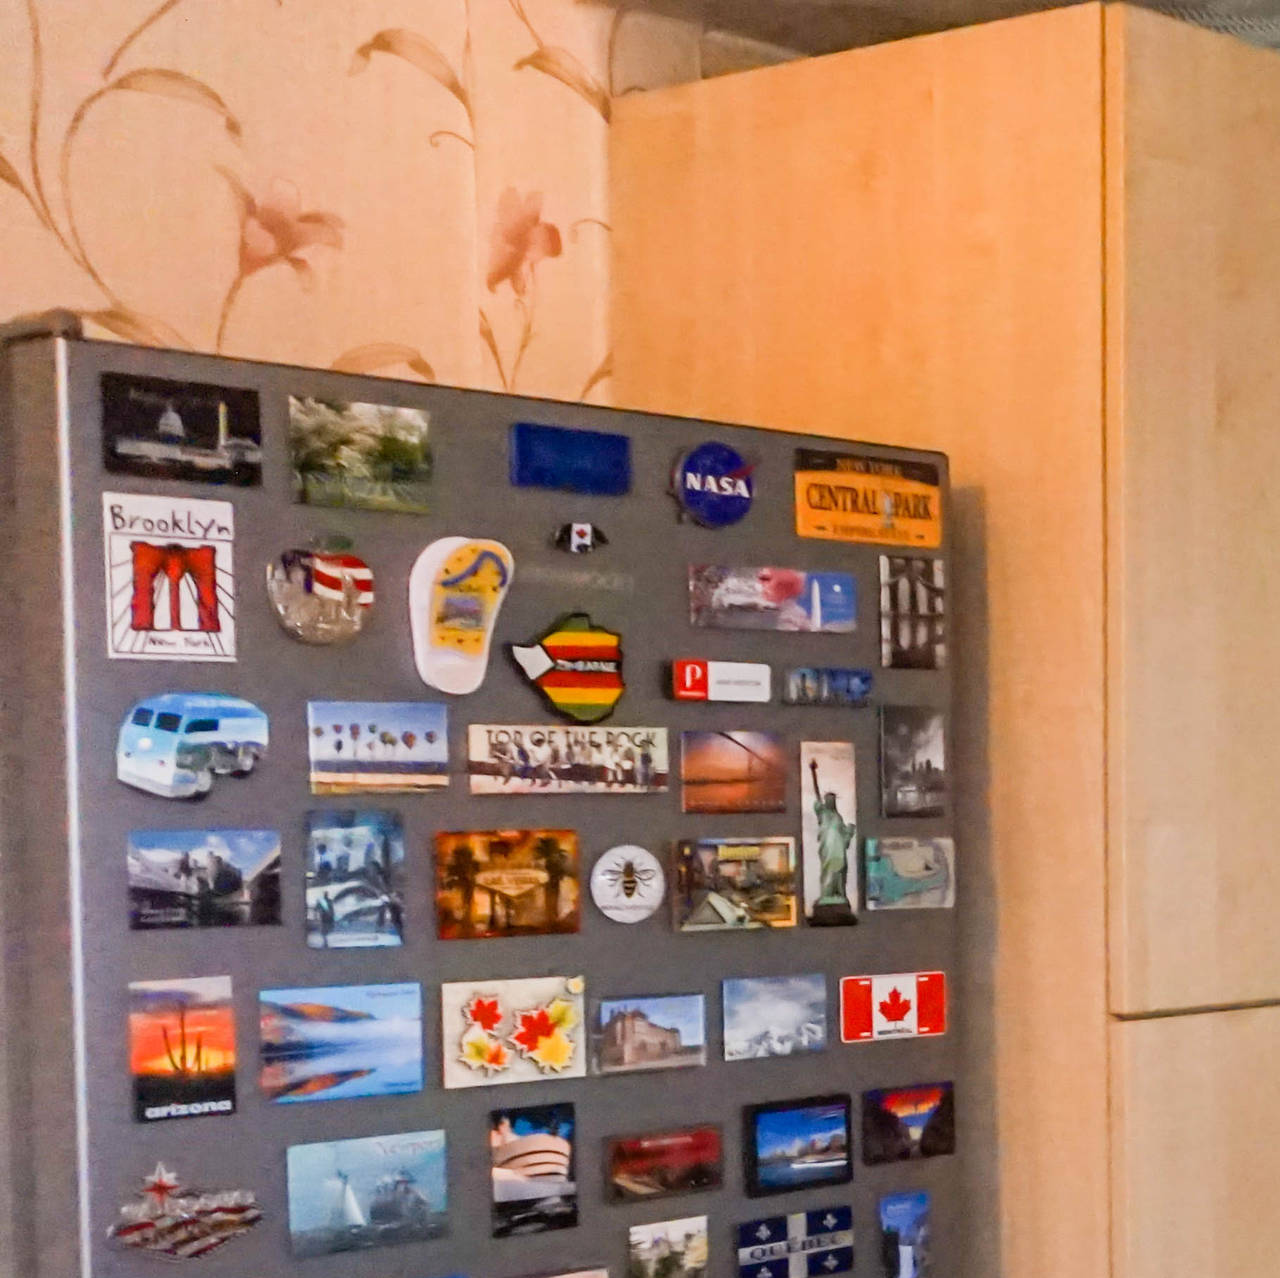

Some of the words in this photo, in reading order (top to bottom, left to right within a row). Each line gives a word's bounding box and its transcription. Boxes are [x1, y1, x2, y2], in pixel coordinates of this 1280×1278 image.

[686, 472, 750, 498] NASA
[806, 483, 878, 515] CENTRAL
[894, 492, 933, 520] PARK
[110, 504, 231, 540] Brooklyn
[145, 1100, 232, 1119] arizona
